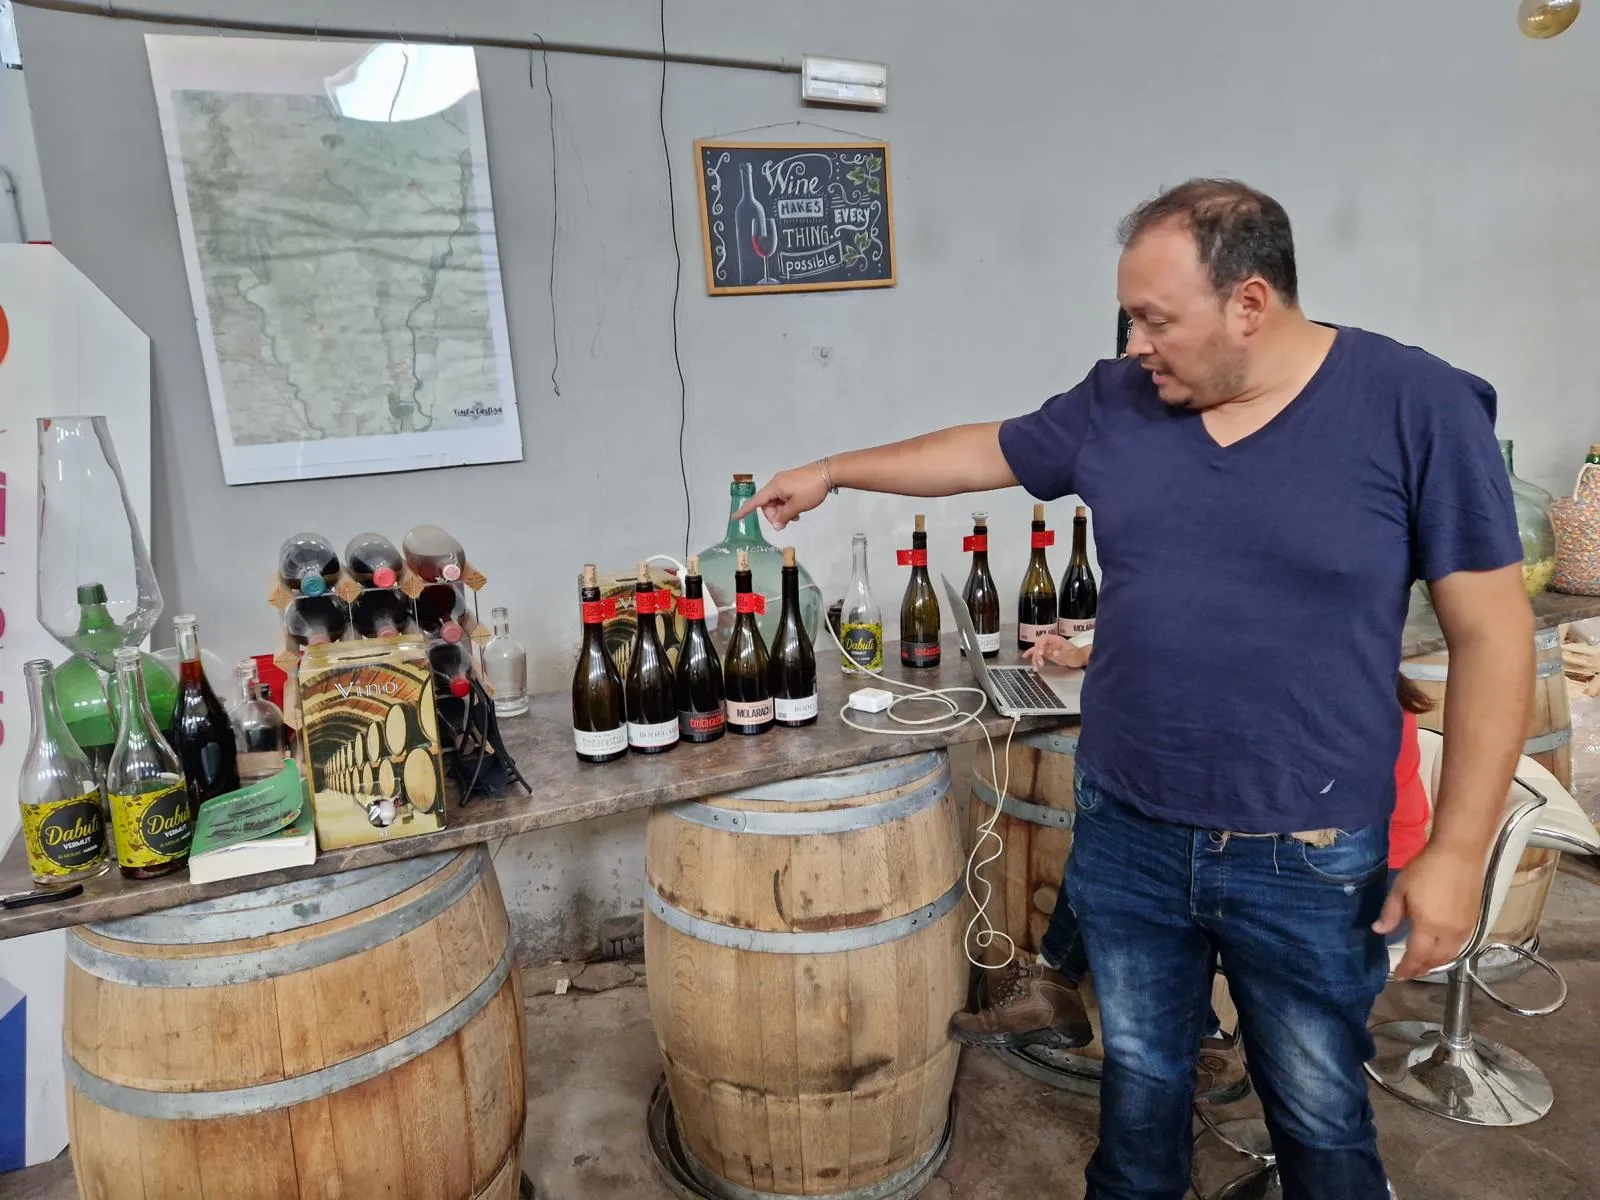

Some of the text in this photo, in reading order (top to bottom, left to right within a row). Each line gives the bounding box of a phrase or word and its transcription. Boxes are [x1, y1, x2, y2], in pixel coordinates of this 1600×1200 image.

[762, 154, 828, 196] Wine
[781, 202, 821, 217] MAKES
[834, 207, 871, 231] EVERY
[786, 251, 836, 279] possible
[334, 680, 398, 699] Vino
[45, 812, 101, 846] Dabuti
[63, 836, 91, 850] VERMUT
